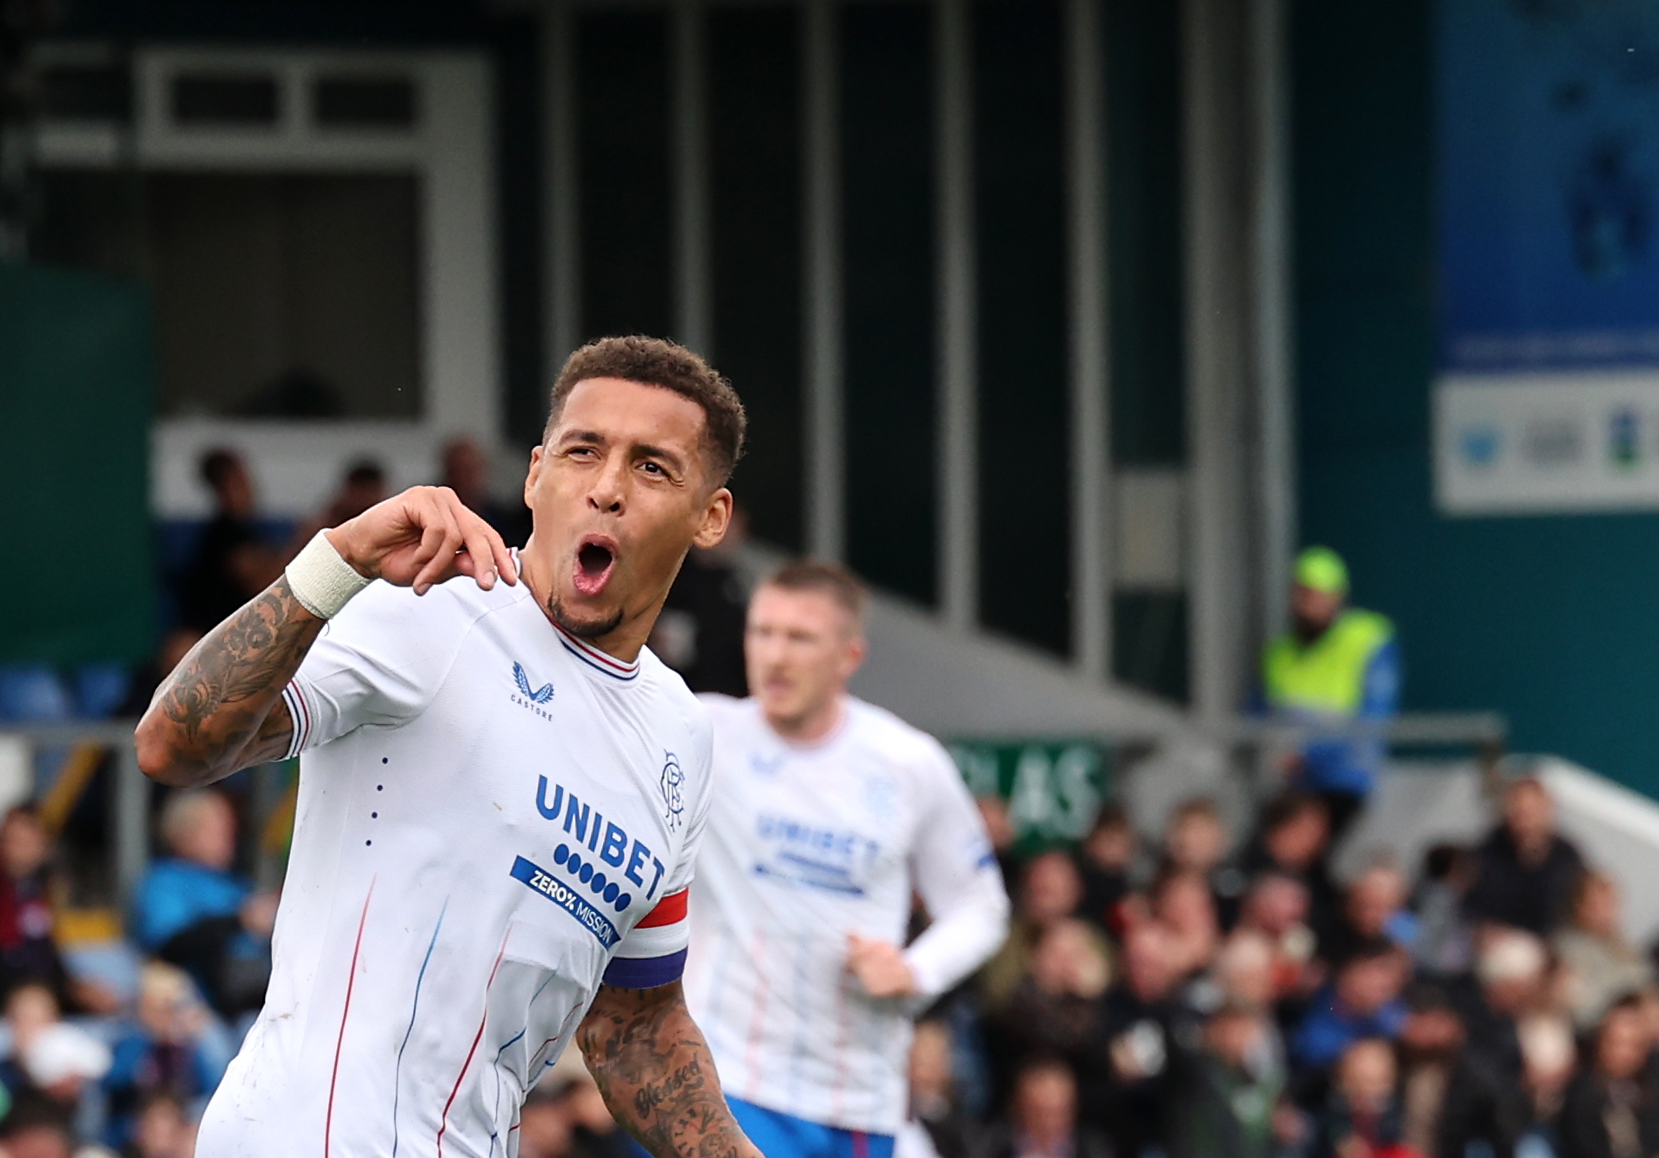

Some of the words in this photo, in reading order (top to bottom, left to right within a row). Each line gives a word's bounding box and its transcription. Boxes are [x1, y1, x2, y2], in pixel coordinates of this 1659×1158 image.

[510, 694, 553, 722] CASTORE
[535, 774, 666, 901] UNIBET
[529, 870, 577, 911] ZERO%
[575, 902, 613, 944] MISSION
